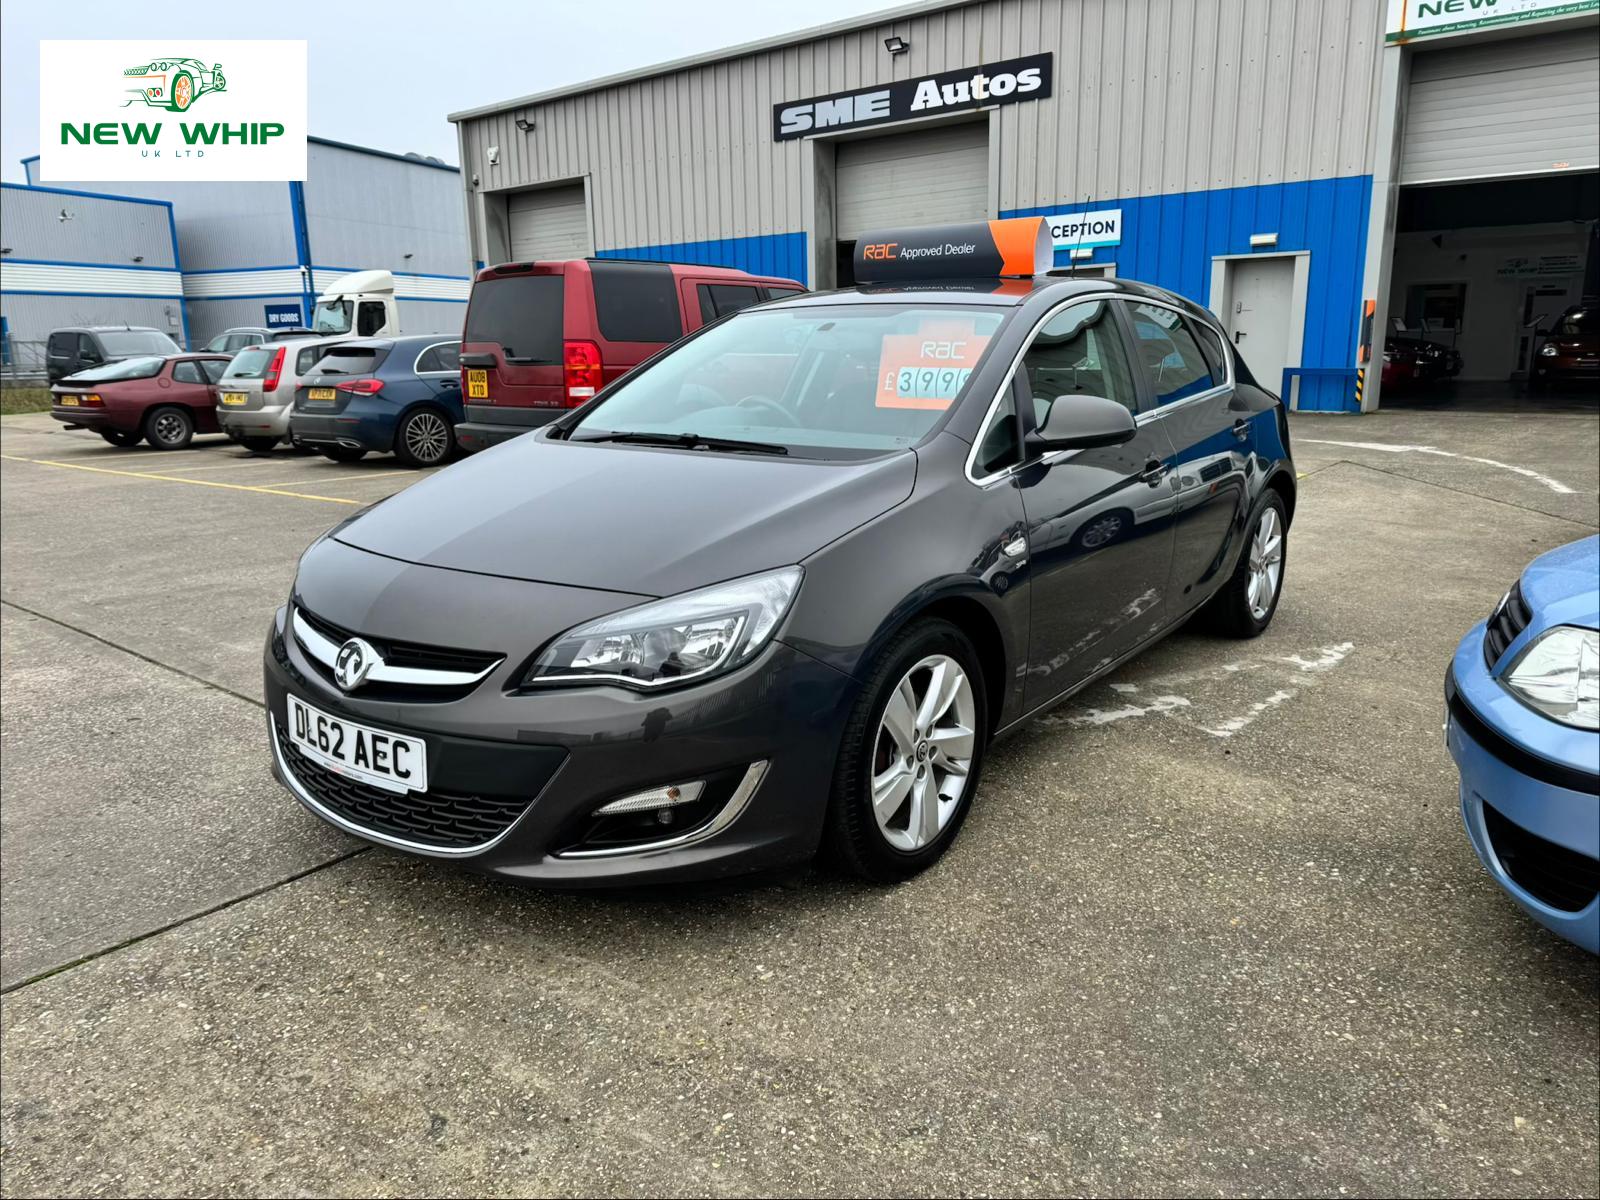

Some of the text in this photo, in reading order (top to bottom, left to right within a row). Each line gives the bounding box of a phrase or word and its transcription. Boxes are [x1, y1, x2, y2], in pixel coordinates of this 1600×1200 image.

[781, 68, 1041, 134] SME Autos
[1051, 220, 1115, 238] CEPTION
[900, 244, 942, 260] Approved
[944, 243, 975, 256] Dealer
[294, 702, 411, 779] DL62 AEC
